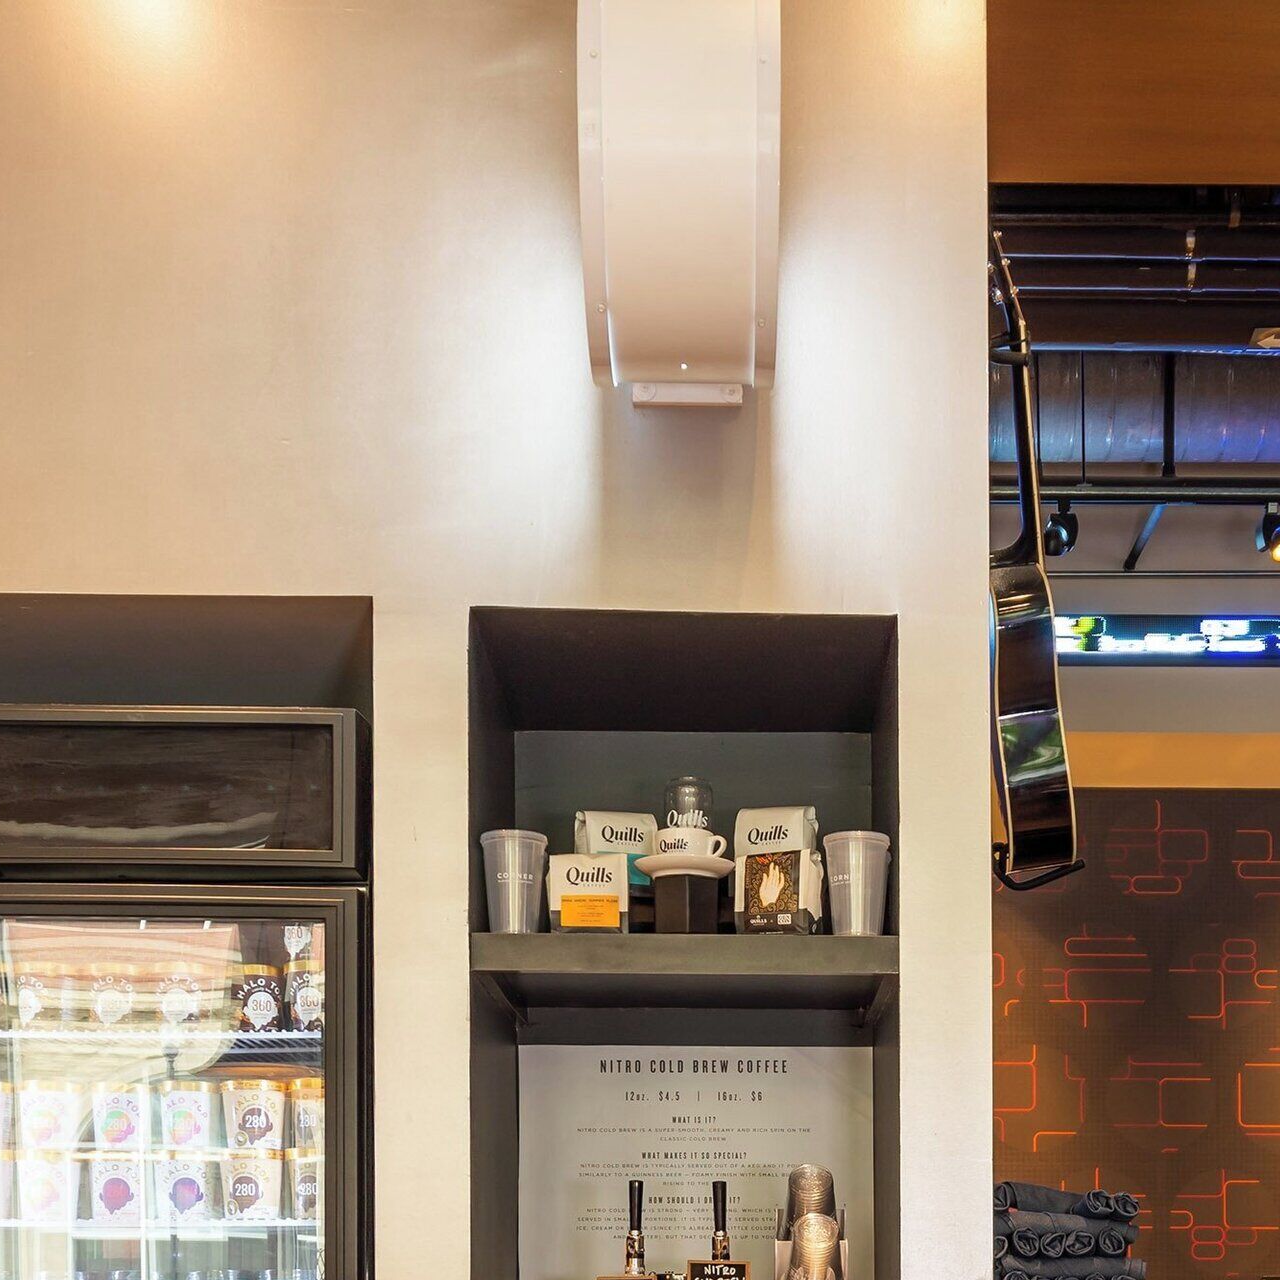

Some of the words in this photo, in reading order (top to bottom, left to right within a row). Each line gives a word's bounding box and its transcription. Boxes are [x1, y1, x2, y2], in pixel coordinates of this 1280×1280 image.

[666, 809, 709, 829] Quills
[601, 825, 645, 844] Quills
[747, 824, 789, 845] Quills
[659, 838, 689, 851] Quills
[496, 872, 535, 880] CONER
[566, 866, 613, 886] Quills
[236, 978, 266, 999] HALO
[252, 1000, 272, 1012] 360
[600, 1059, 641, 1074] NITRO
[650, 1059, 684, 1074] COLD
[693, 1059, 729, 1074] BREW
[737, 1059, 789, 1074] COFFEE
[625, 1091, 650, 1102] 12oz.
[658, 1090, 680, 1102] $4.5
[718, 1091, 742, 1102] 16oz.
[751, 1090, 763, 1102] $6
[245, 1115, 266, 1128] 280
[672, 1116, 691, 1124] WHAT
[694, 1116, 701, 1124] IS
[705, 1116, 716, 1124] IT?
[713, 1152, 747, 1160] SPECIAL?
[235, 1183, 256, 1196] 280
[648, 1196, 663, 1204] HOW
[666, 1196, 694, 1204] SHOULD
[703, 1264, 736, 1276] NITRO
